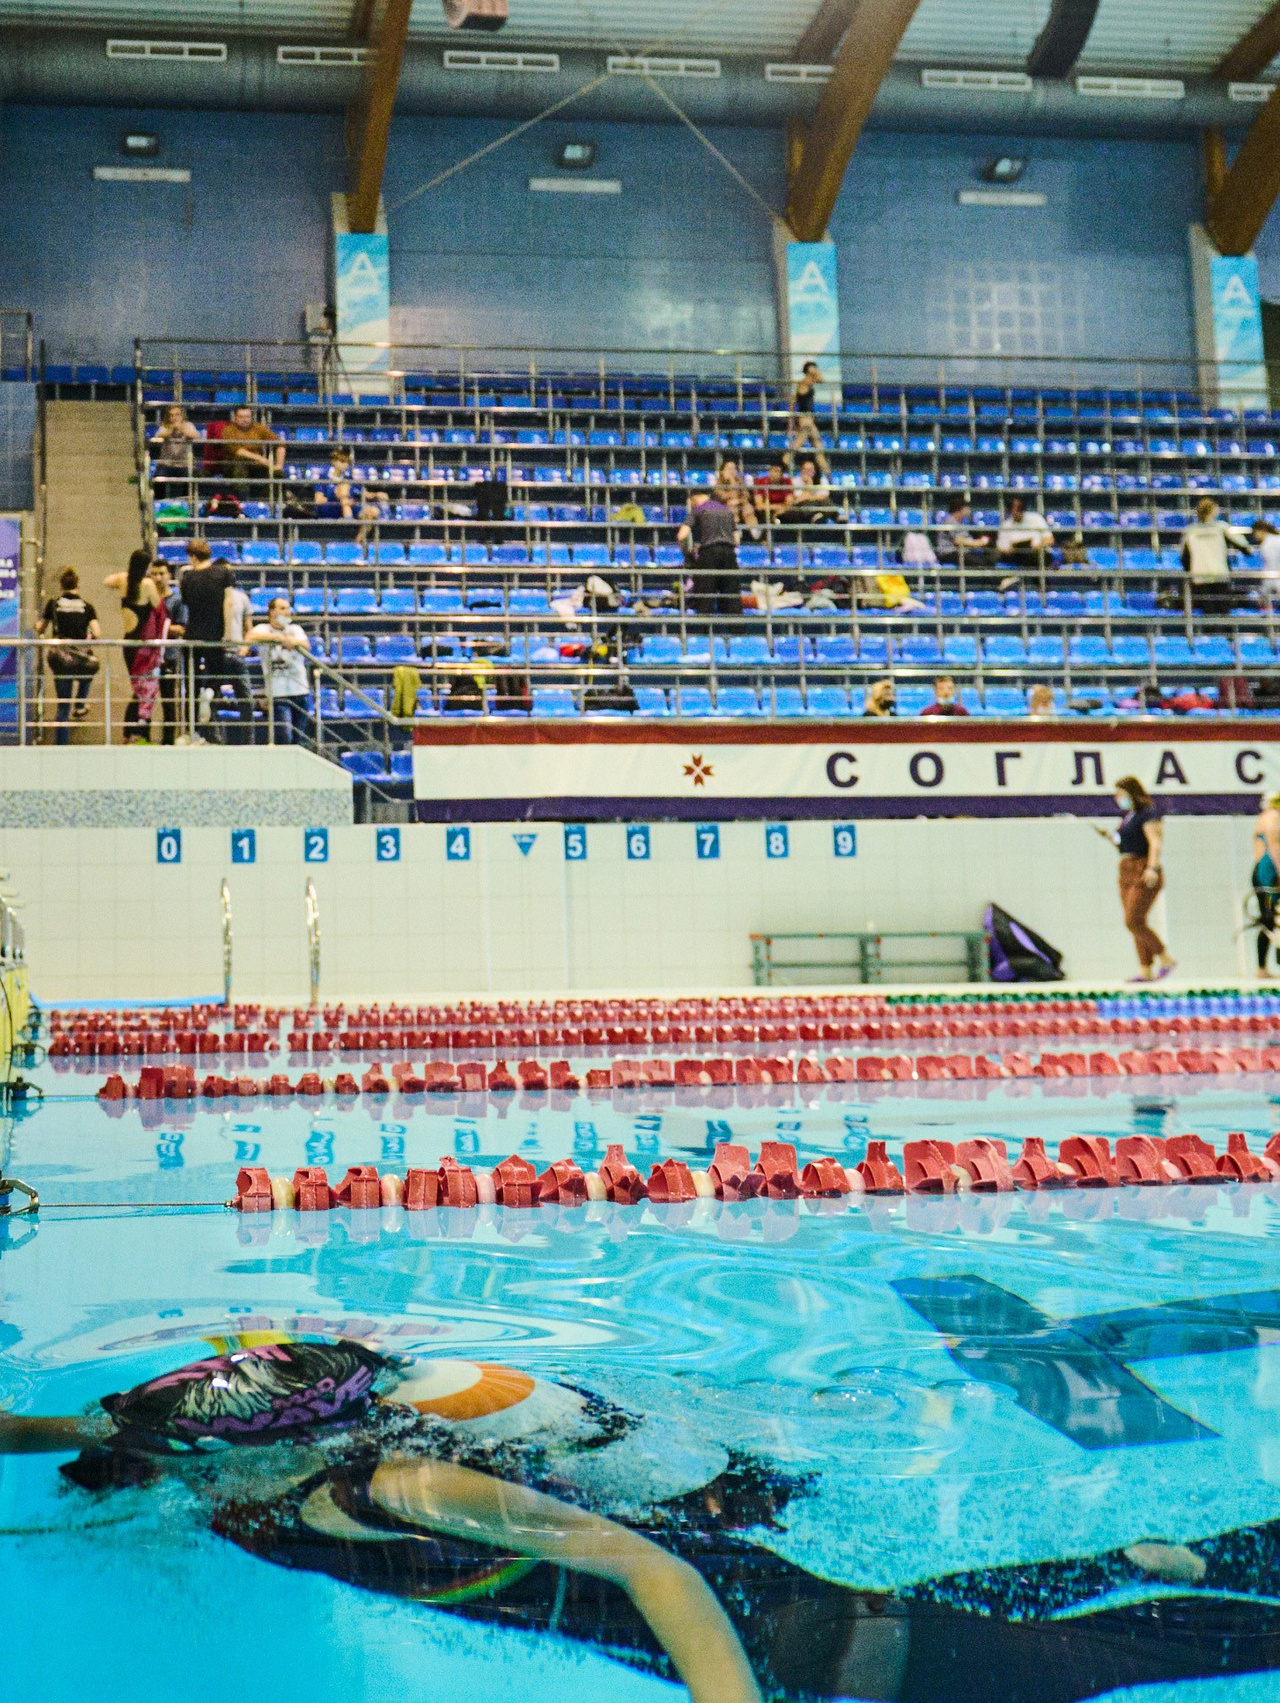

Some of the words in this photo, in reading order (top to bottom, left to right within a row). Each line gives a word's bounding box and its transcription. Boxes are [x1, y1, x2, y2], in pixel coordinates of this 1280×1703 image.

[825, 749, 1266, 789] СОГЛАС
[160, 836, 178, 861] 0
[237, 837, 250, 860] 1
[308, 835, 325, 860] 2
[380, 835, 397, 859] 3
[449, 833, 467, 858] 4
[567, 834, 583, 857] 5
[629, 833, 647, 858] 6
[699, 833, 715, 856] 7
[769, 832, 785, 856] 8
[836, 830, 854, 855] 9
